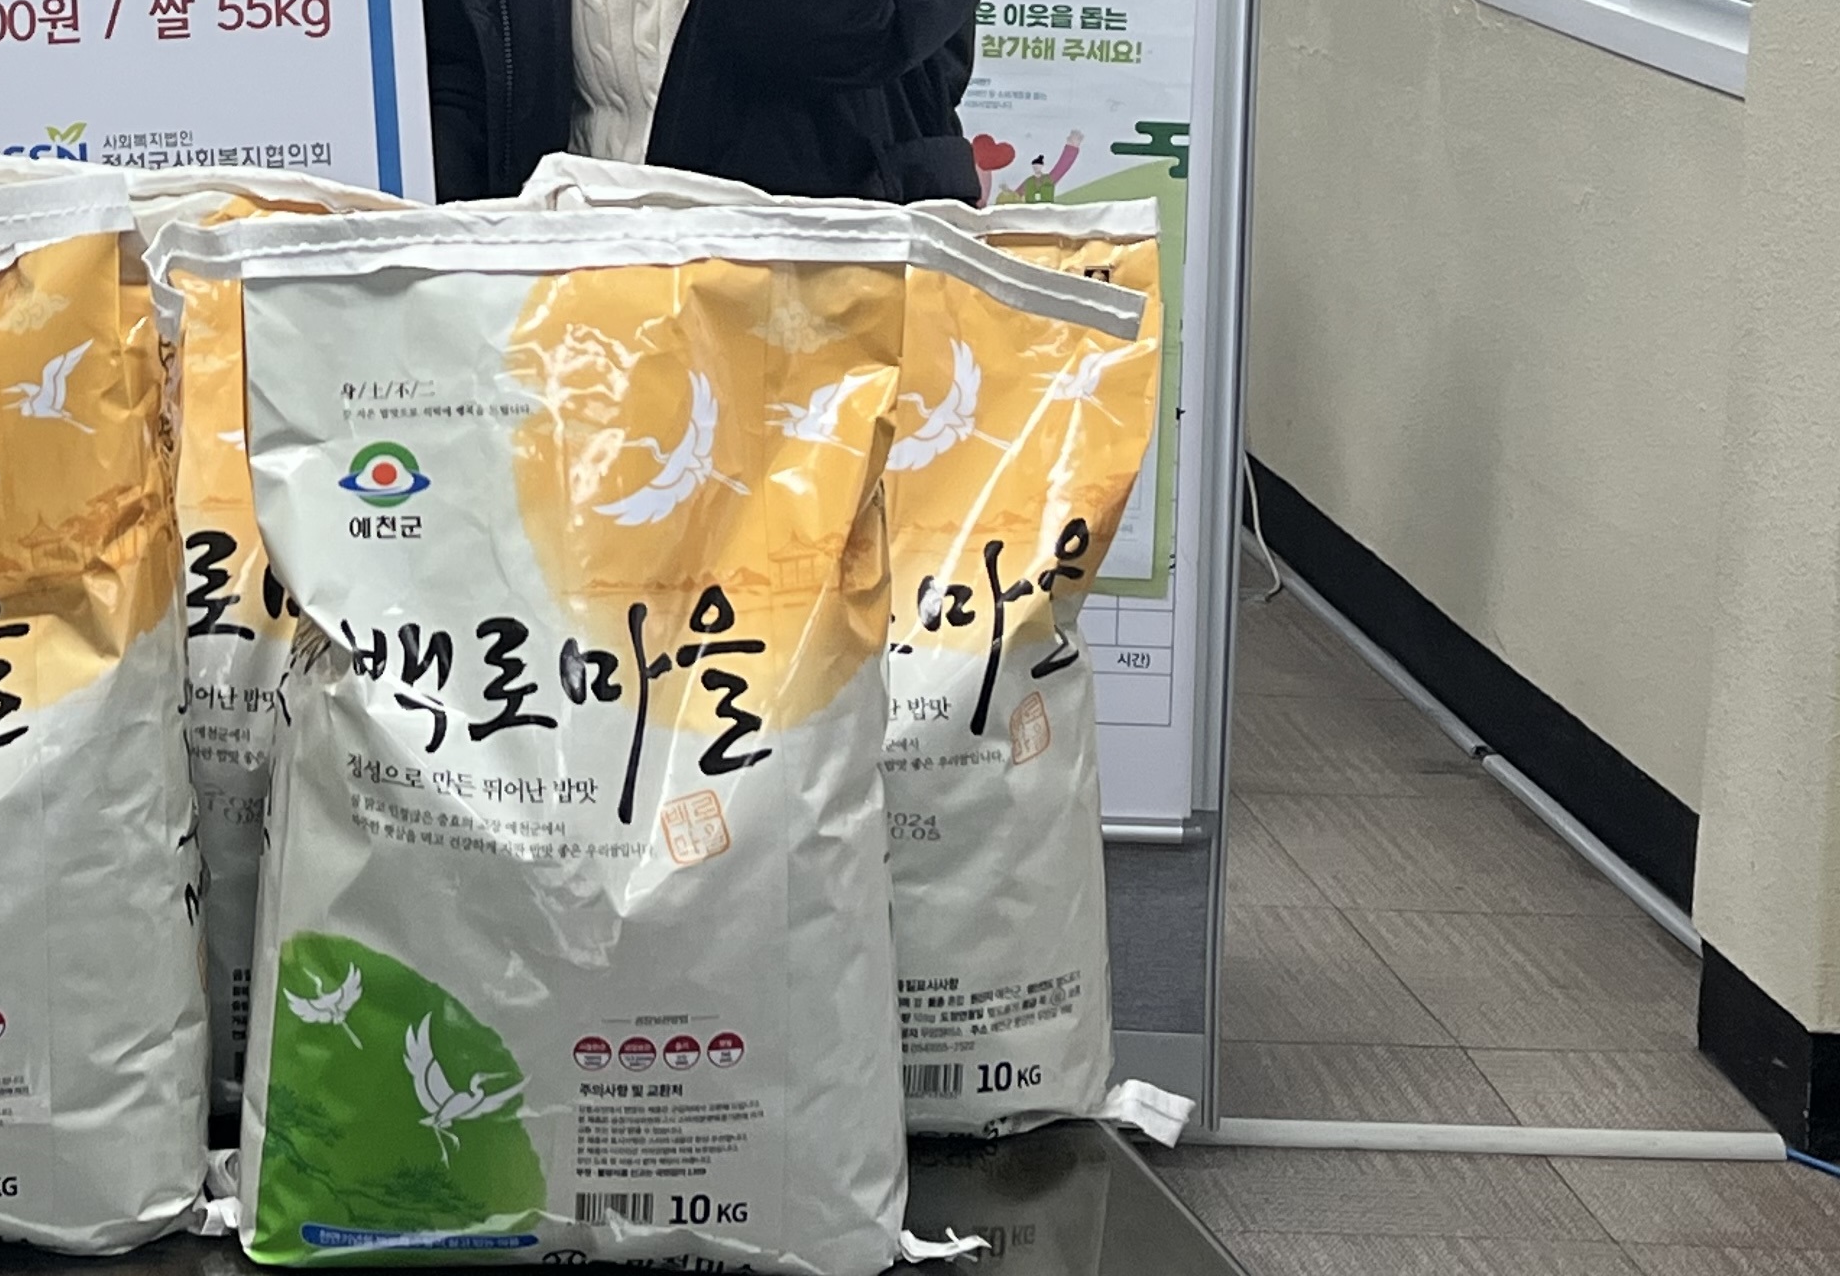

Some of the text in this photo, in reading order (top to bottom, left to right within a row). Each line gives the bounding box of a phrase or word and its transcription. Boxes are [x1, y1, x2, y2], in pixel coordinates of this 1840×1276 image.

[1004, 4, 1073, 29] 이웃을
[1080, 6, 1127, 31] 돕는
[982, 35, 1143, 64] 참가해 주세요!
[103, 130, 193, 149] 사회복지법인
[349, 515, 422, 539] 예천군
[1117, 652, 1150, 670] 시간)
[340, 585, 772, 825] 백로마을
[908, 696, 951, 720] 밥맛
[346, 753, 598, 804] 정성으로 만든 뛰어난 밥맛
[579, 1083, 628, 1098] 주의사항
[632, 1084, 644, 1097] 및
[977, 1062, 1041, 1093] 10 KG
[669, 1194, 748, 1225] 10 KG
